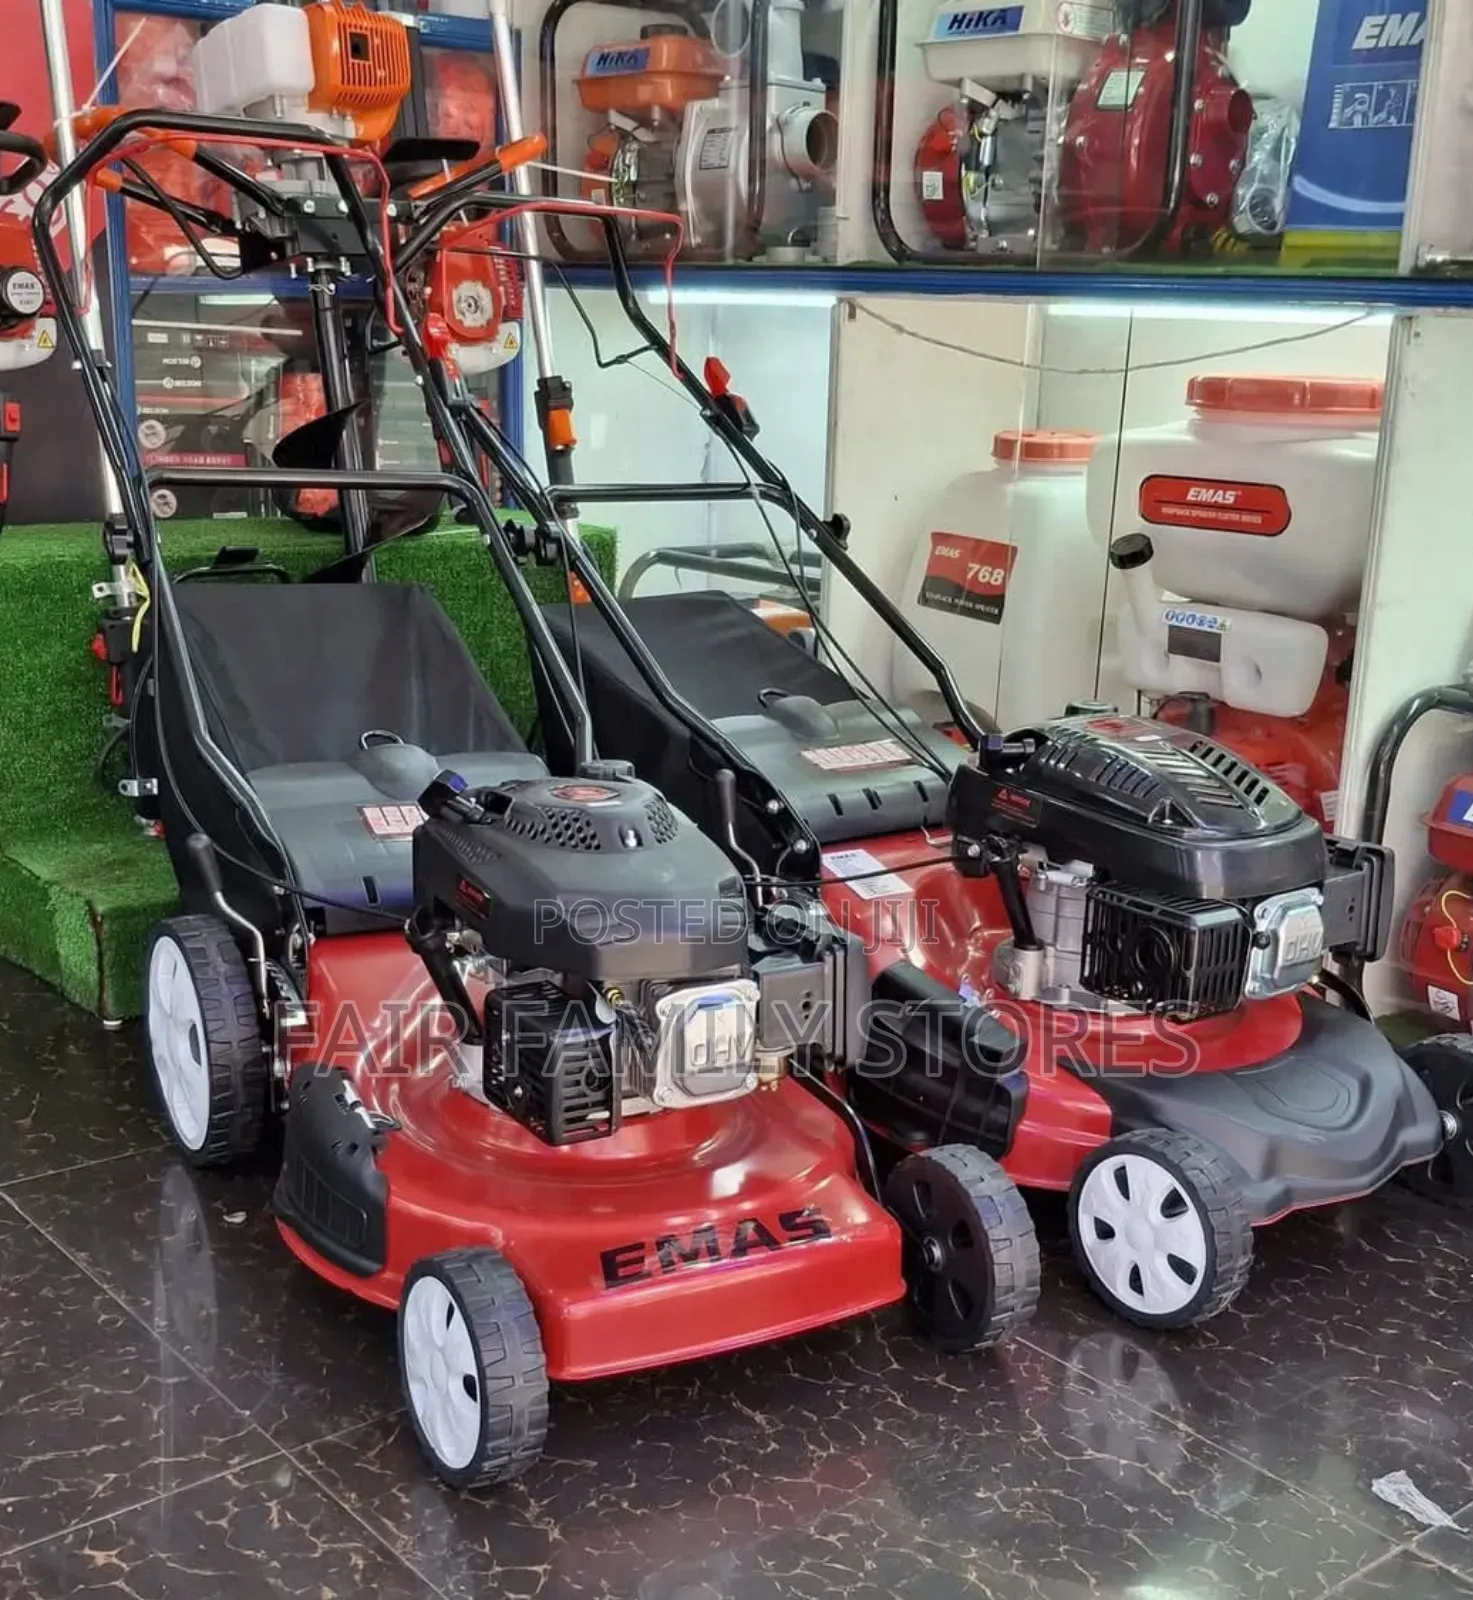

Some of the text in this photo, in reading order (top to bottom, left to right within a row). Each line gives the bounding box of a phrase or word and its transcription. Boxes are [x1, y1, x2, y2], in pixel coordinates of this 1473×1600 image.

[1186, 487, 1236, 504] EMAS
[935, 545, 961, 559] EMAS
[966, 563, 1005, 585] 768
[600, 1208, 833, 1290] EMAS
